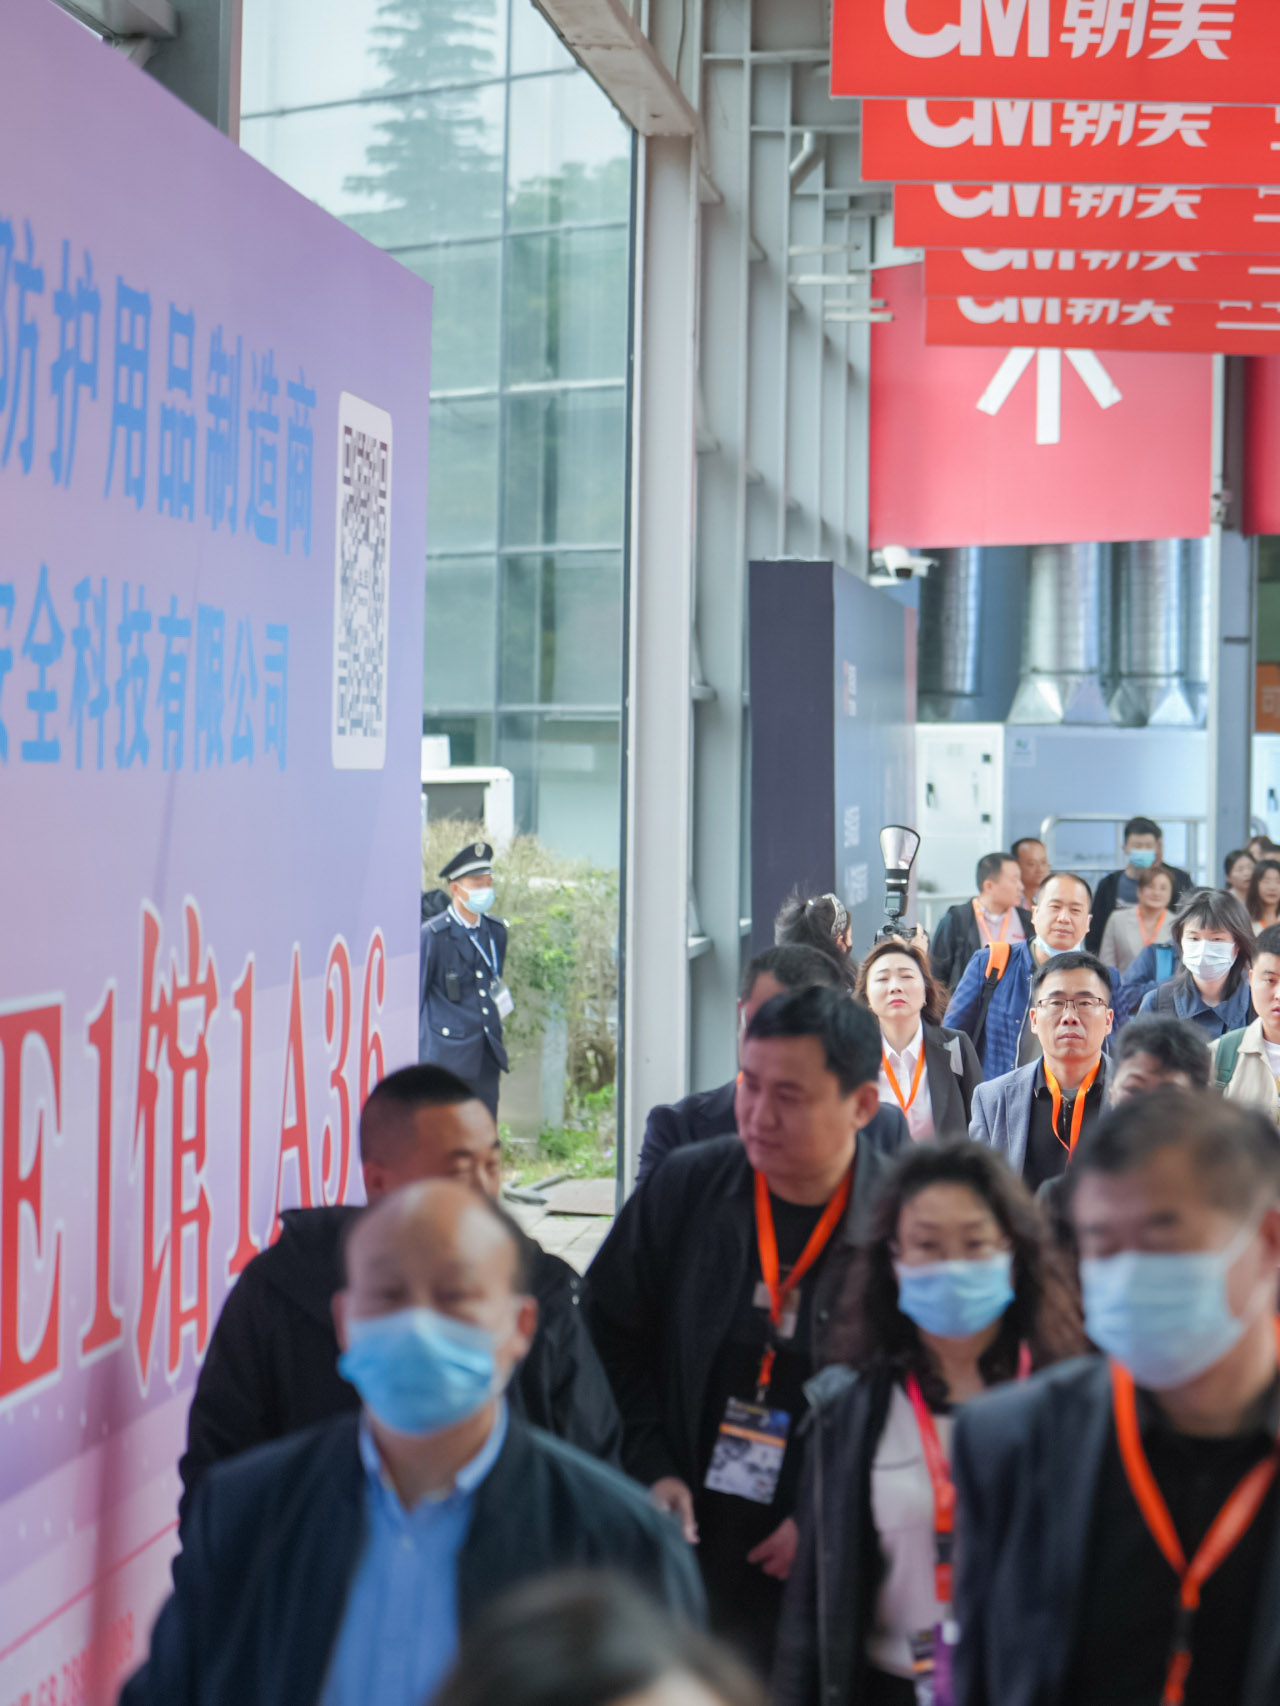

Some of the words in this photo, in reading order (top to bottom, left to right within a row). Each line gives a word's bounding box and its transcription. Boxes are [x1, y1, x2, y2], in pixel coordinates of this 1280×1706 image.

[0, 218, 317, 559] 防护用品制造商
